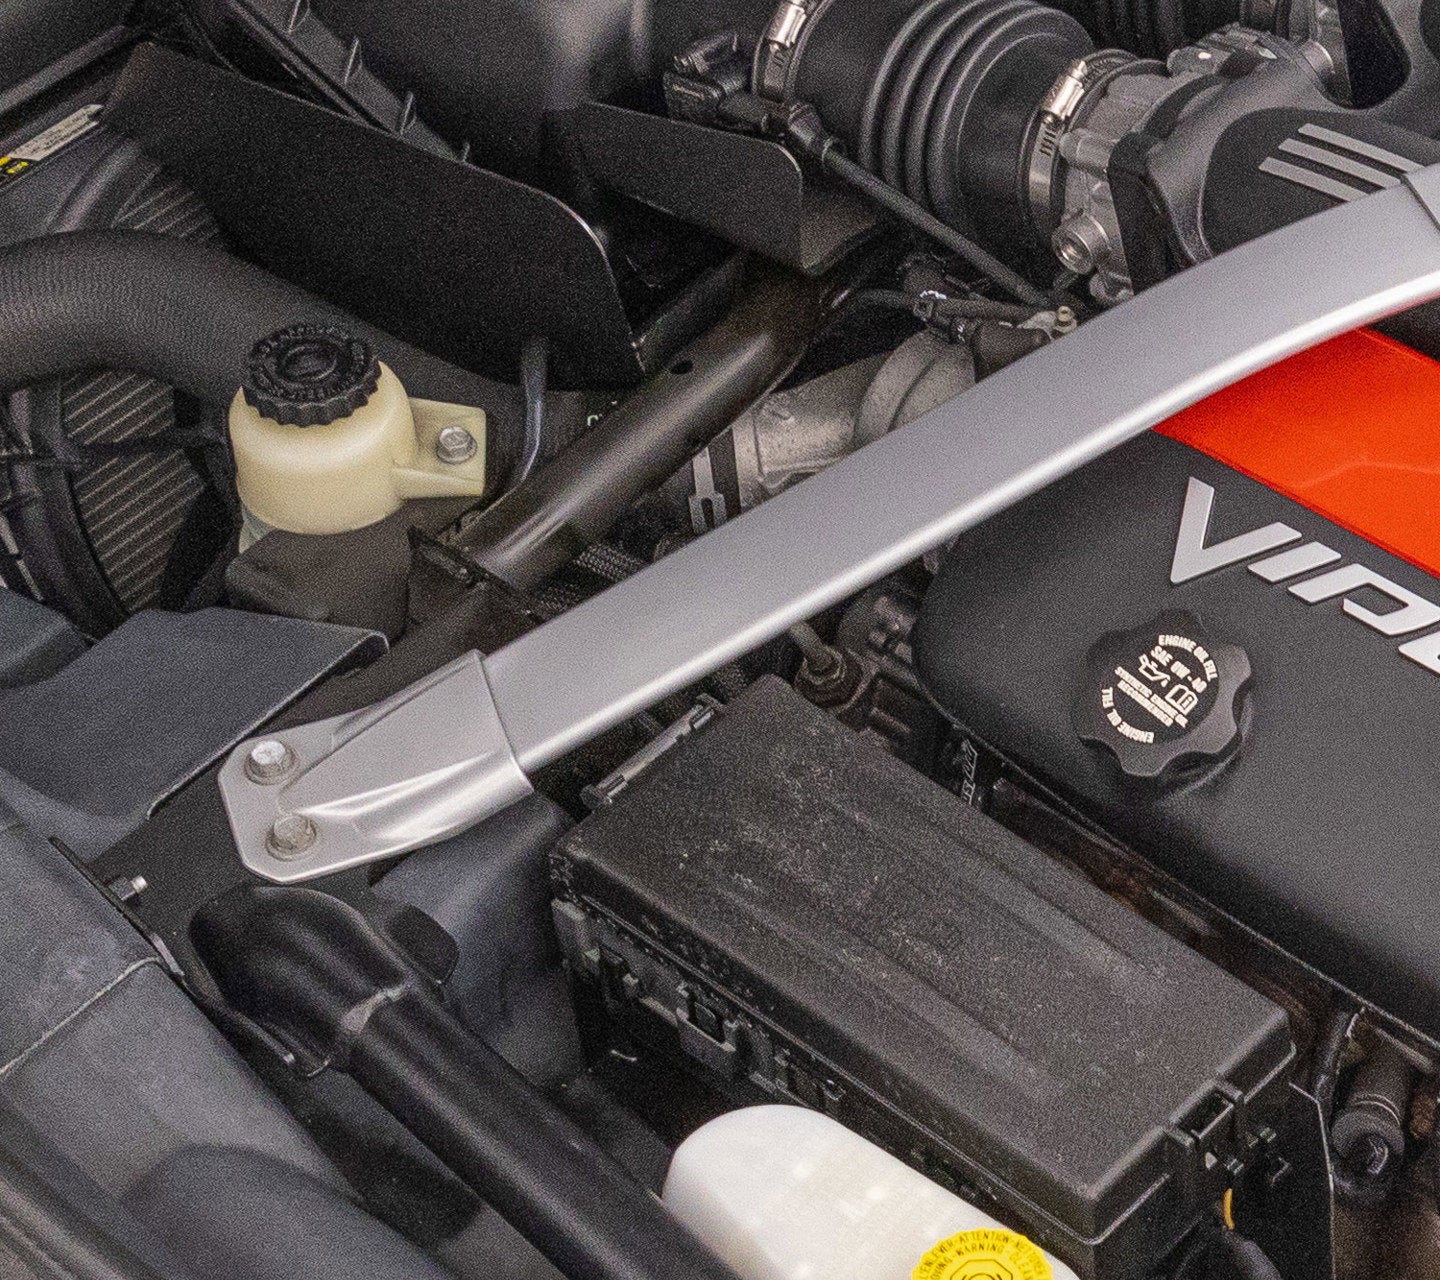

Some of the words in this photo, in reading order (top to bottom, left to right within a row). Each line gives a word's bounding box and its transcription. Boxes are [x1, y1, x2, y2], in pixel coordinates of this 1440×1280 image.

[1150, 645, 1173, 667] SAE
[1158, 634, 1197, 653] ENGINE
[1193, 645, 1209, 663] OIL
[1203, 659, 1218, 682] FILL
[1114, 666, 1153, 698] SYNTHETIC
[1150, 693, 1179, 720] ENGINE
[1117, 679, 1174, 728] RECOMMENDED
[1116, 721, 1155, 744] ENGINE
